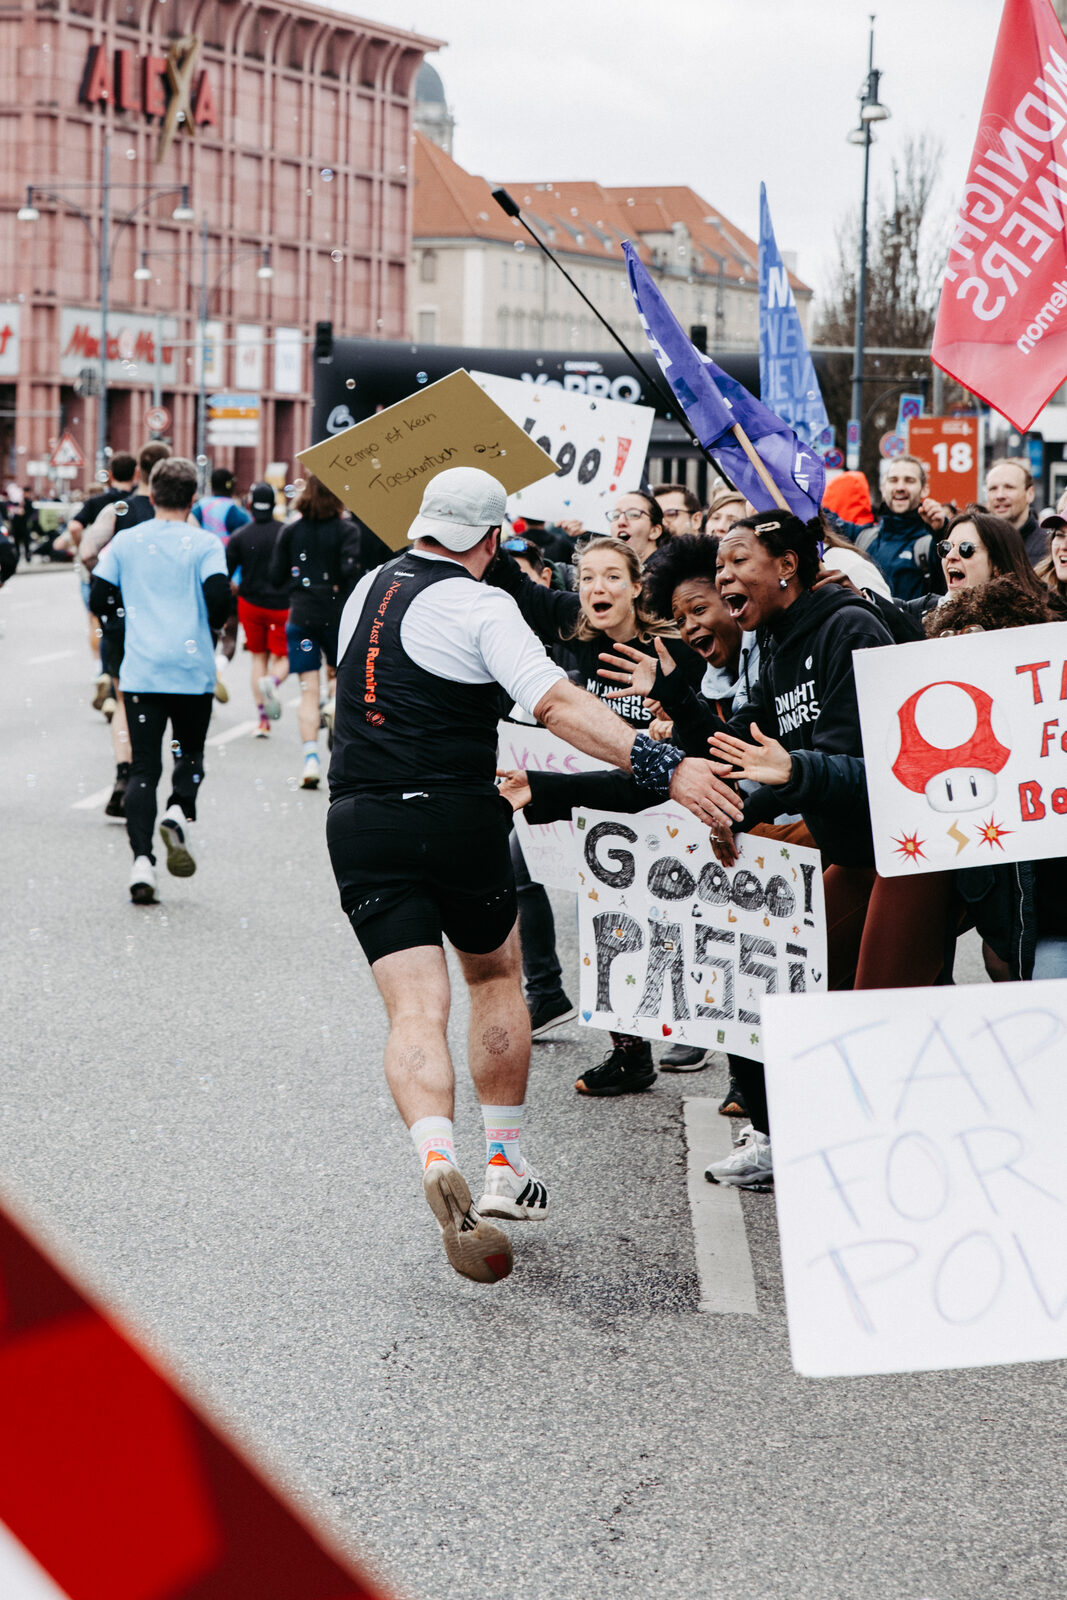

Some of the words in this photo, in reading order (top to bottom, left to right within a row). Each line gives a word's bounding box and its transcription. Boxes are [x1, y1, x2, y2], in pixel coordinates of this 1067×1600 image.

[78, 36, 218, 162] ALEXA
[329, 442, 380, 473] Tempo
[385, 426, 404, 445] ist
[403, 412, 437, 433] kein
[368, 446, 458, 494] Taschentuch
[932, 442, 973, 473] 18
[377, 579, 402, 617] Never
[369, 617, 385, 644] Just
[364, 647, 380, 703] Running
[790, 1007, 1065, 1121] TAP
[786, 1126, 1067, 1228] FOR
